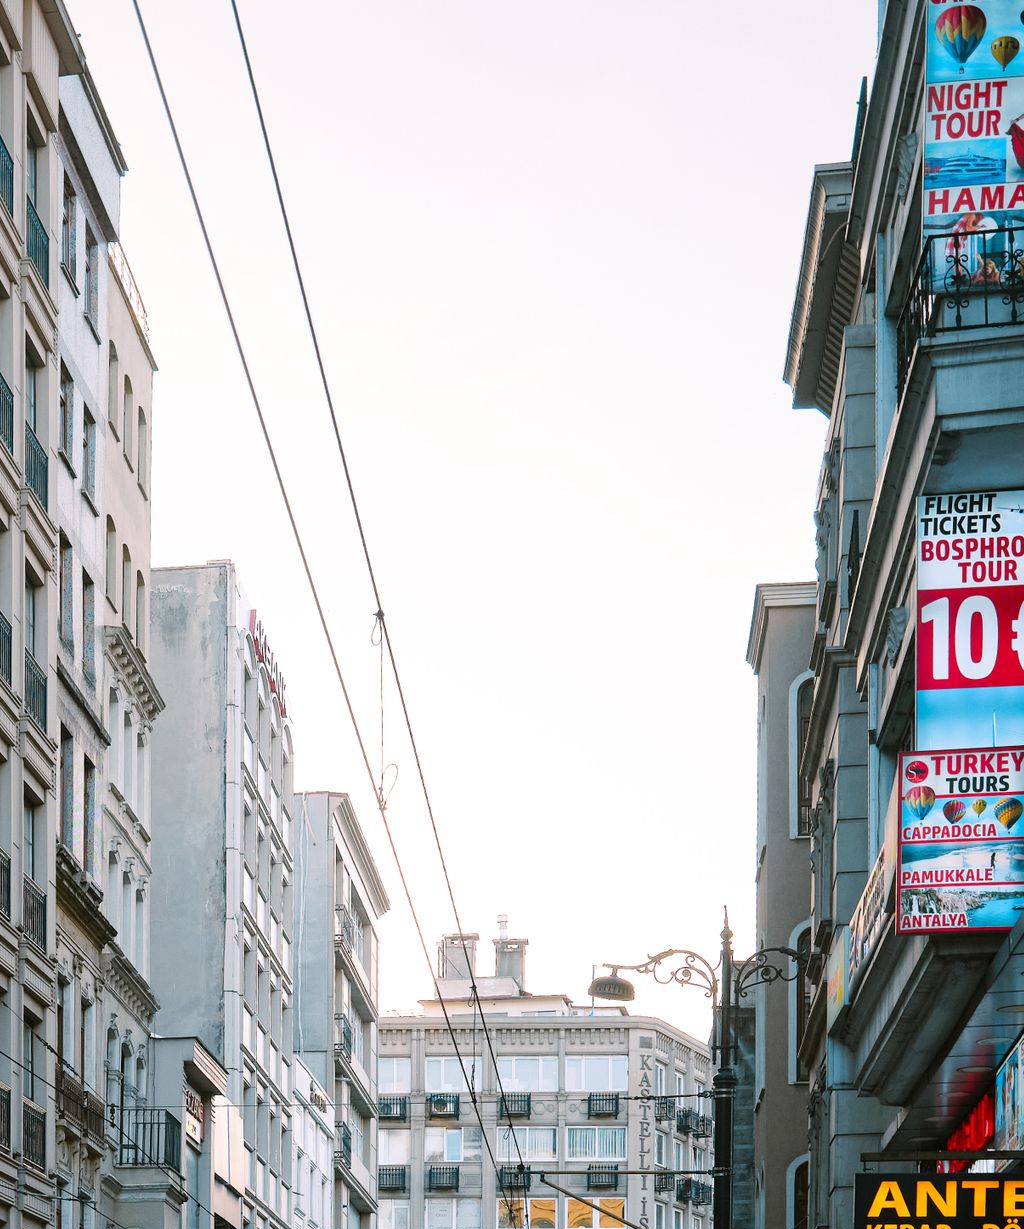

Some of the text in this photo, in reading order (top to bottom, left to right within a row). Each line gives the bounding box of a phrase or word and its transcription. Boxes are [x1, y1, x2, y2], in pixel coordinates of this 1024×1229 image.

[928, 81, 1007, 112] NIGHT
[931, 110, 1001, 140] TOUR
[925, 494, 996, 515] FLIGHT
[921, 514, 1000, 535] TICKETS
[958, 560, 1017, 583] TOUR
[931, 752, 1024, 776] TURKEY
[946, 775, 1010, 794] TOURS
[903, 823, 997, 840] CAPPADOCIA
[902, 868, 993, 884] PAMUKKALE
[902, 913, 967, 929] ANTALYA
